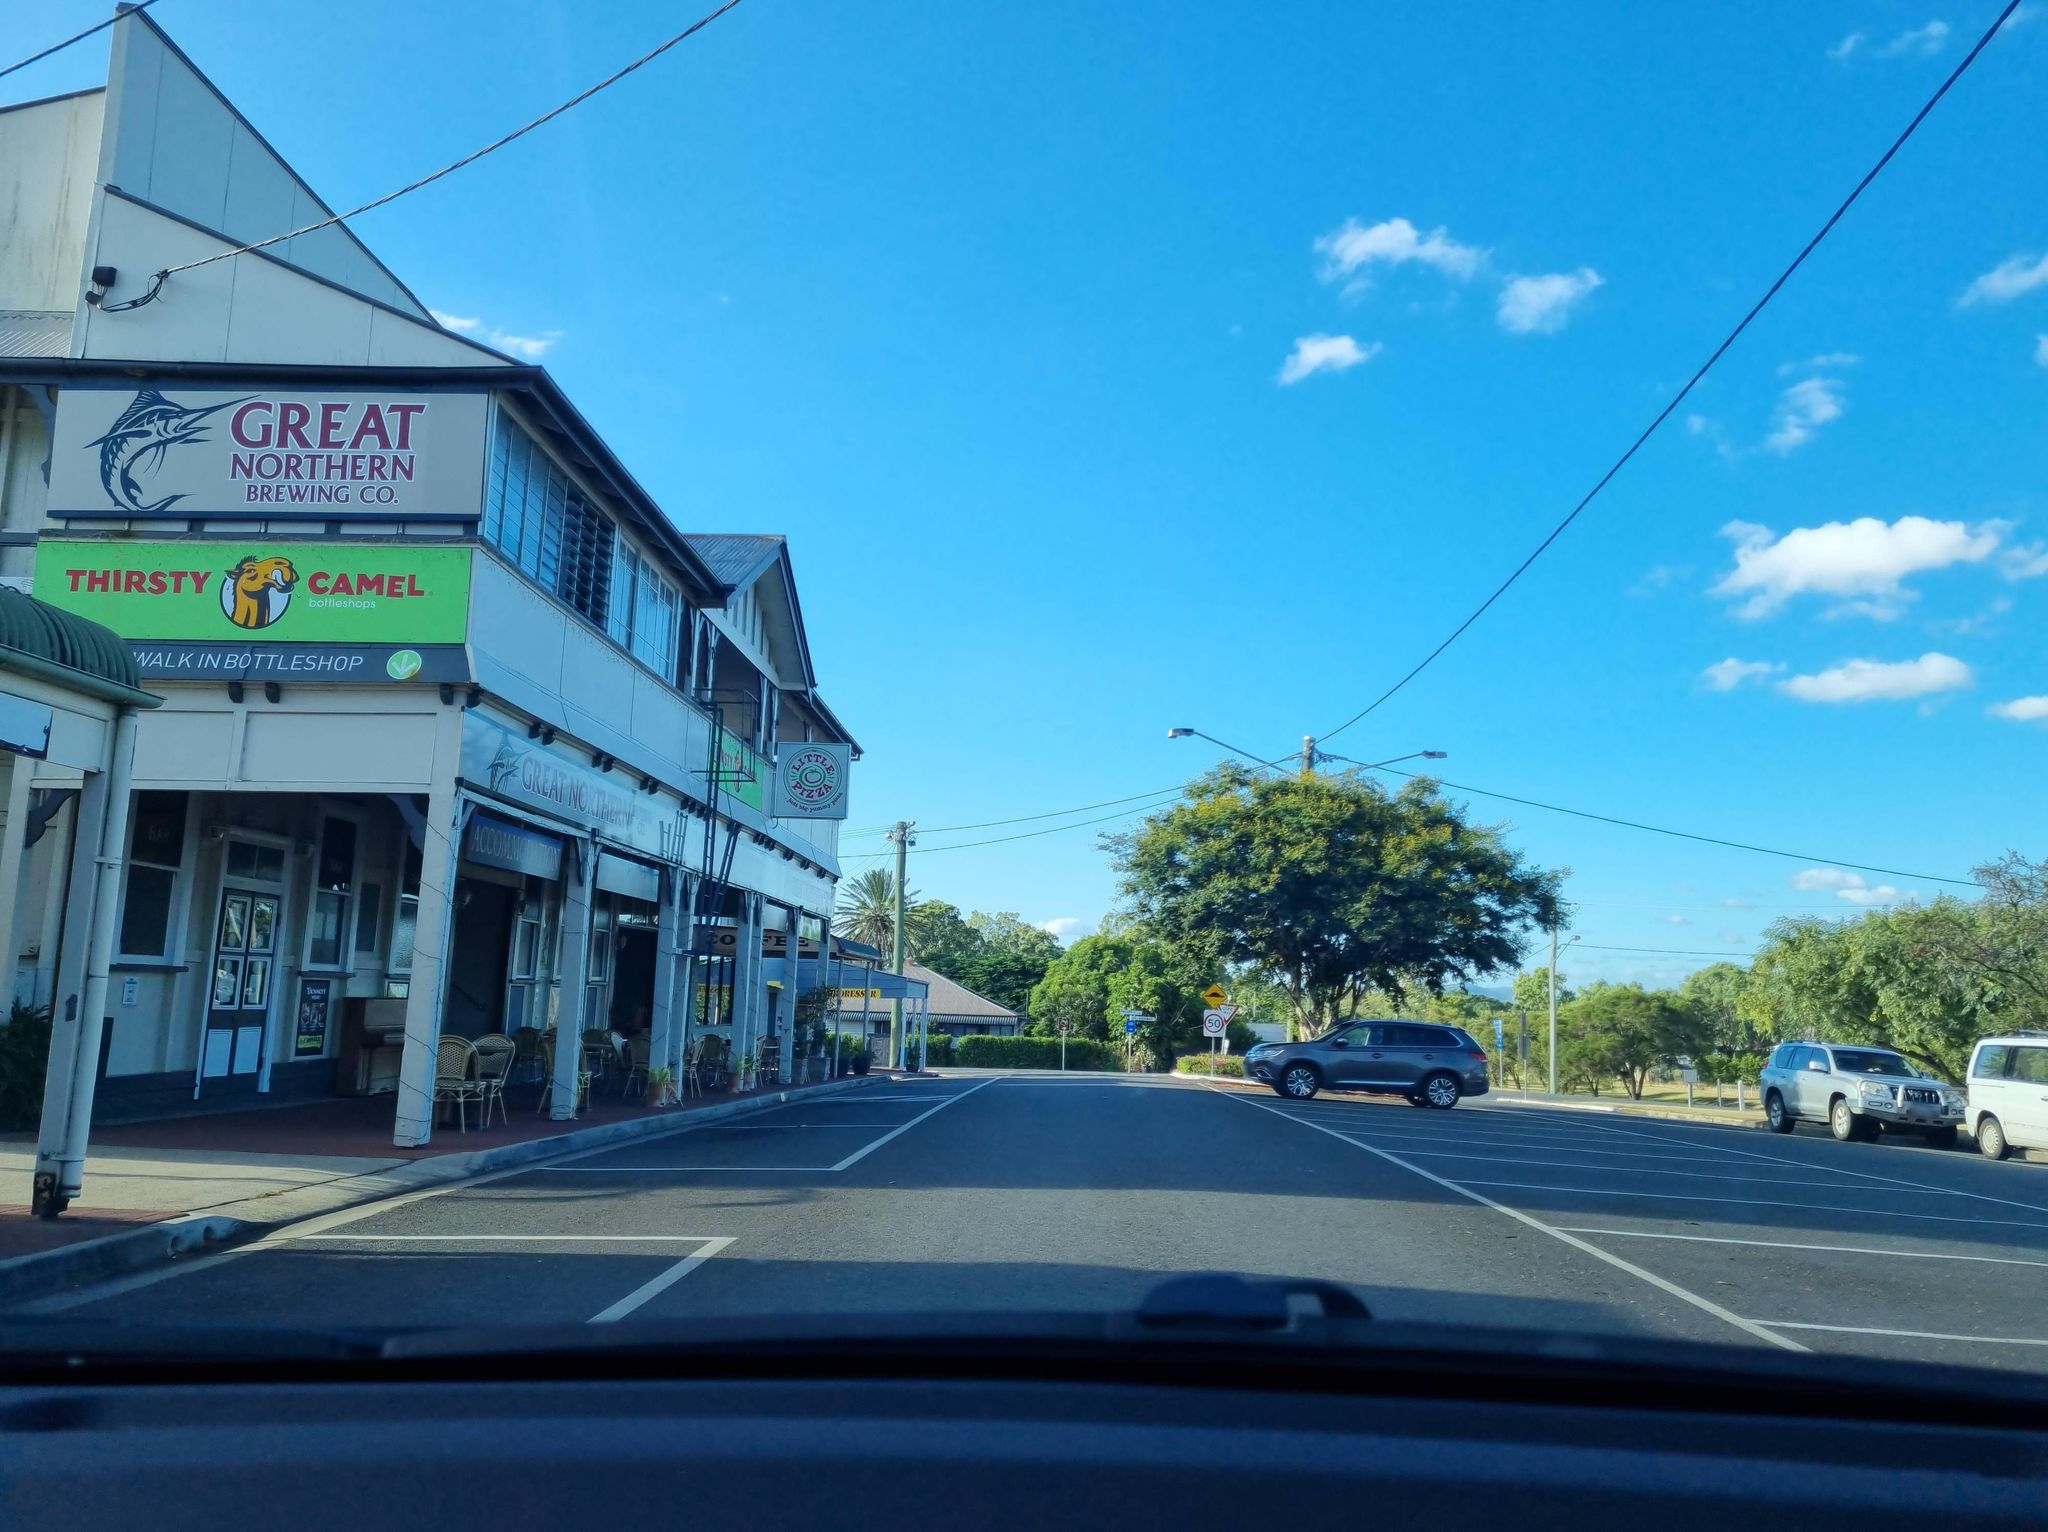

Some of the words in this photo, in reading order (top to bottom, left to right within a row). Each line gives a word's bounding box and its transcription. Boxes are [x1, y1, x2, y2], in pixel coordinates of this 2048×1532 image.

[230, 401, 427, 451] GREAT
[229, 452, 416, 482] NORTHERN
[245, 484, 350, 504] BREWING
[359, 485, 400, 505] CO.
[65, 569, 212, 595] THIRSTY
[307, 572, 426, 599] CAMEL
[308, 596, 377, 611] bottleshops
[133, 651, 192, 670] WALK
[197, 652, 221, 670] IN
[223, 652, 364, 673] BOTTLESHOP
[791, 754, 835, 774] LITTLE
[522, 756, 566, 805] GREAT
[568, 777, 634, 827] NORTHERN
[791, 781, 833, 799] PIZZA
[471, 824, 561, 872] ACCOMMOTION
[708, 934, 809, 947] COFEE
[1207, 1018, 1221, 1029] 50
